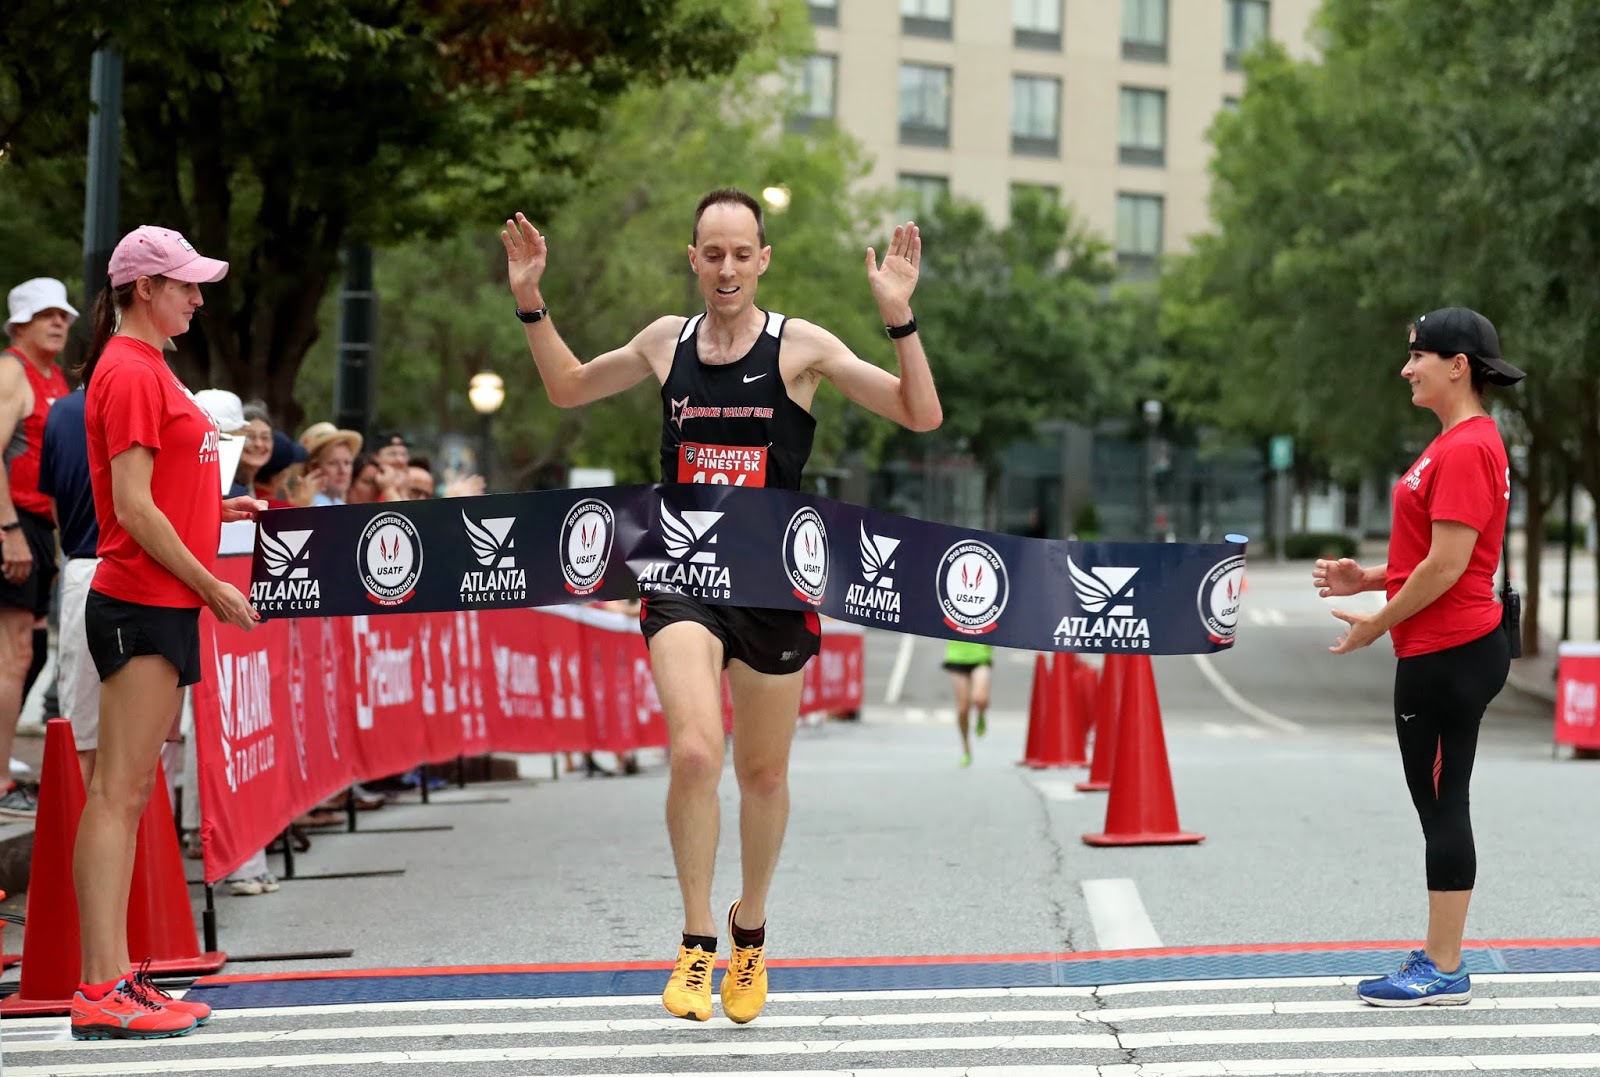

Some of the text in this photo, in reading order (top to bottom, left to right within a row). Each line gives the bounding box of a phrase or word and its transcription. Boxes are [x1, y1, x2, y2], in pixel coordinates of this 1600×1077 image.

[682, 407, 774, 418] ROANOKE VALLEY ELITE
[698, 448, 760, 460] ATLANTA'S
[697, 458, 759, 471] FINEST 5K
[577, 504, 602, 515] MASTERS
[366, 524, 377, 539] 2018
[376, 517, 402, 526] MASTERS
[405, 525, 414, 536] KM
[576, 554, 597, 564] USATF
[960, 545, 988, 557] MASTERS
[990, 558, 1000, 570] KM
[377, 566, 403, 575] USATF
[566, 560, 605, 586] CHAMPIONSHIPS
[637, 562, 731, 588] ATLANTA
[366, 571, 416, 596] CHAMPIONSHIPS
[460, 569, 527, 592] ATLANTA
[249, 579, 321, 601] ATLANTA
[460, 590, 526, 603] TRACK CLUB
[637, 583, 731, 599] TRACK CLUB
[845, 583, 901, 613] ATLANTA
[956, 593, 985, 604] USATF
[252, 600, 320, 611] RACK CLUB
[845, 604, 900, 624] TRACK CLUB
[944, 599, 998, 625] CHAMPIONSHIPS
[1053, 616, 1150, 639] ATLANTA
[1054, 637, 1150, 649] TRACK CLUB
